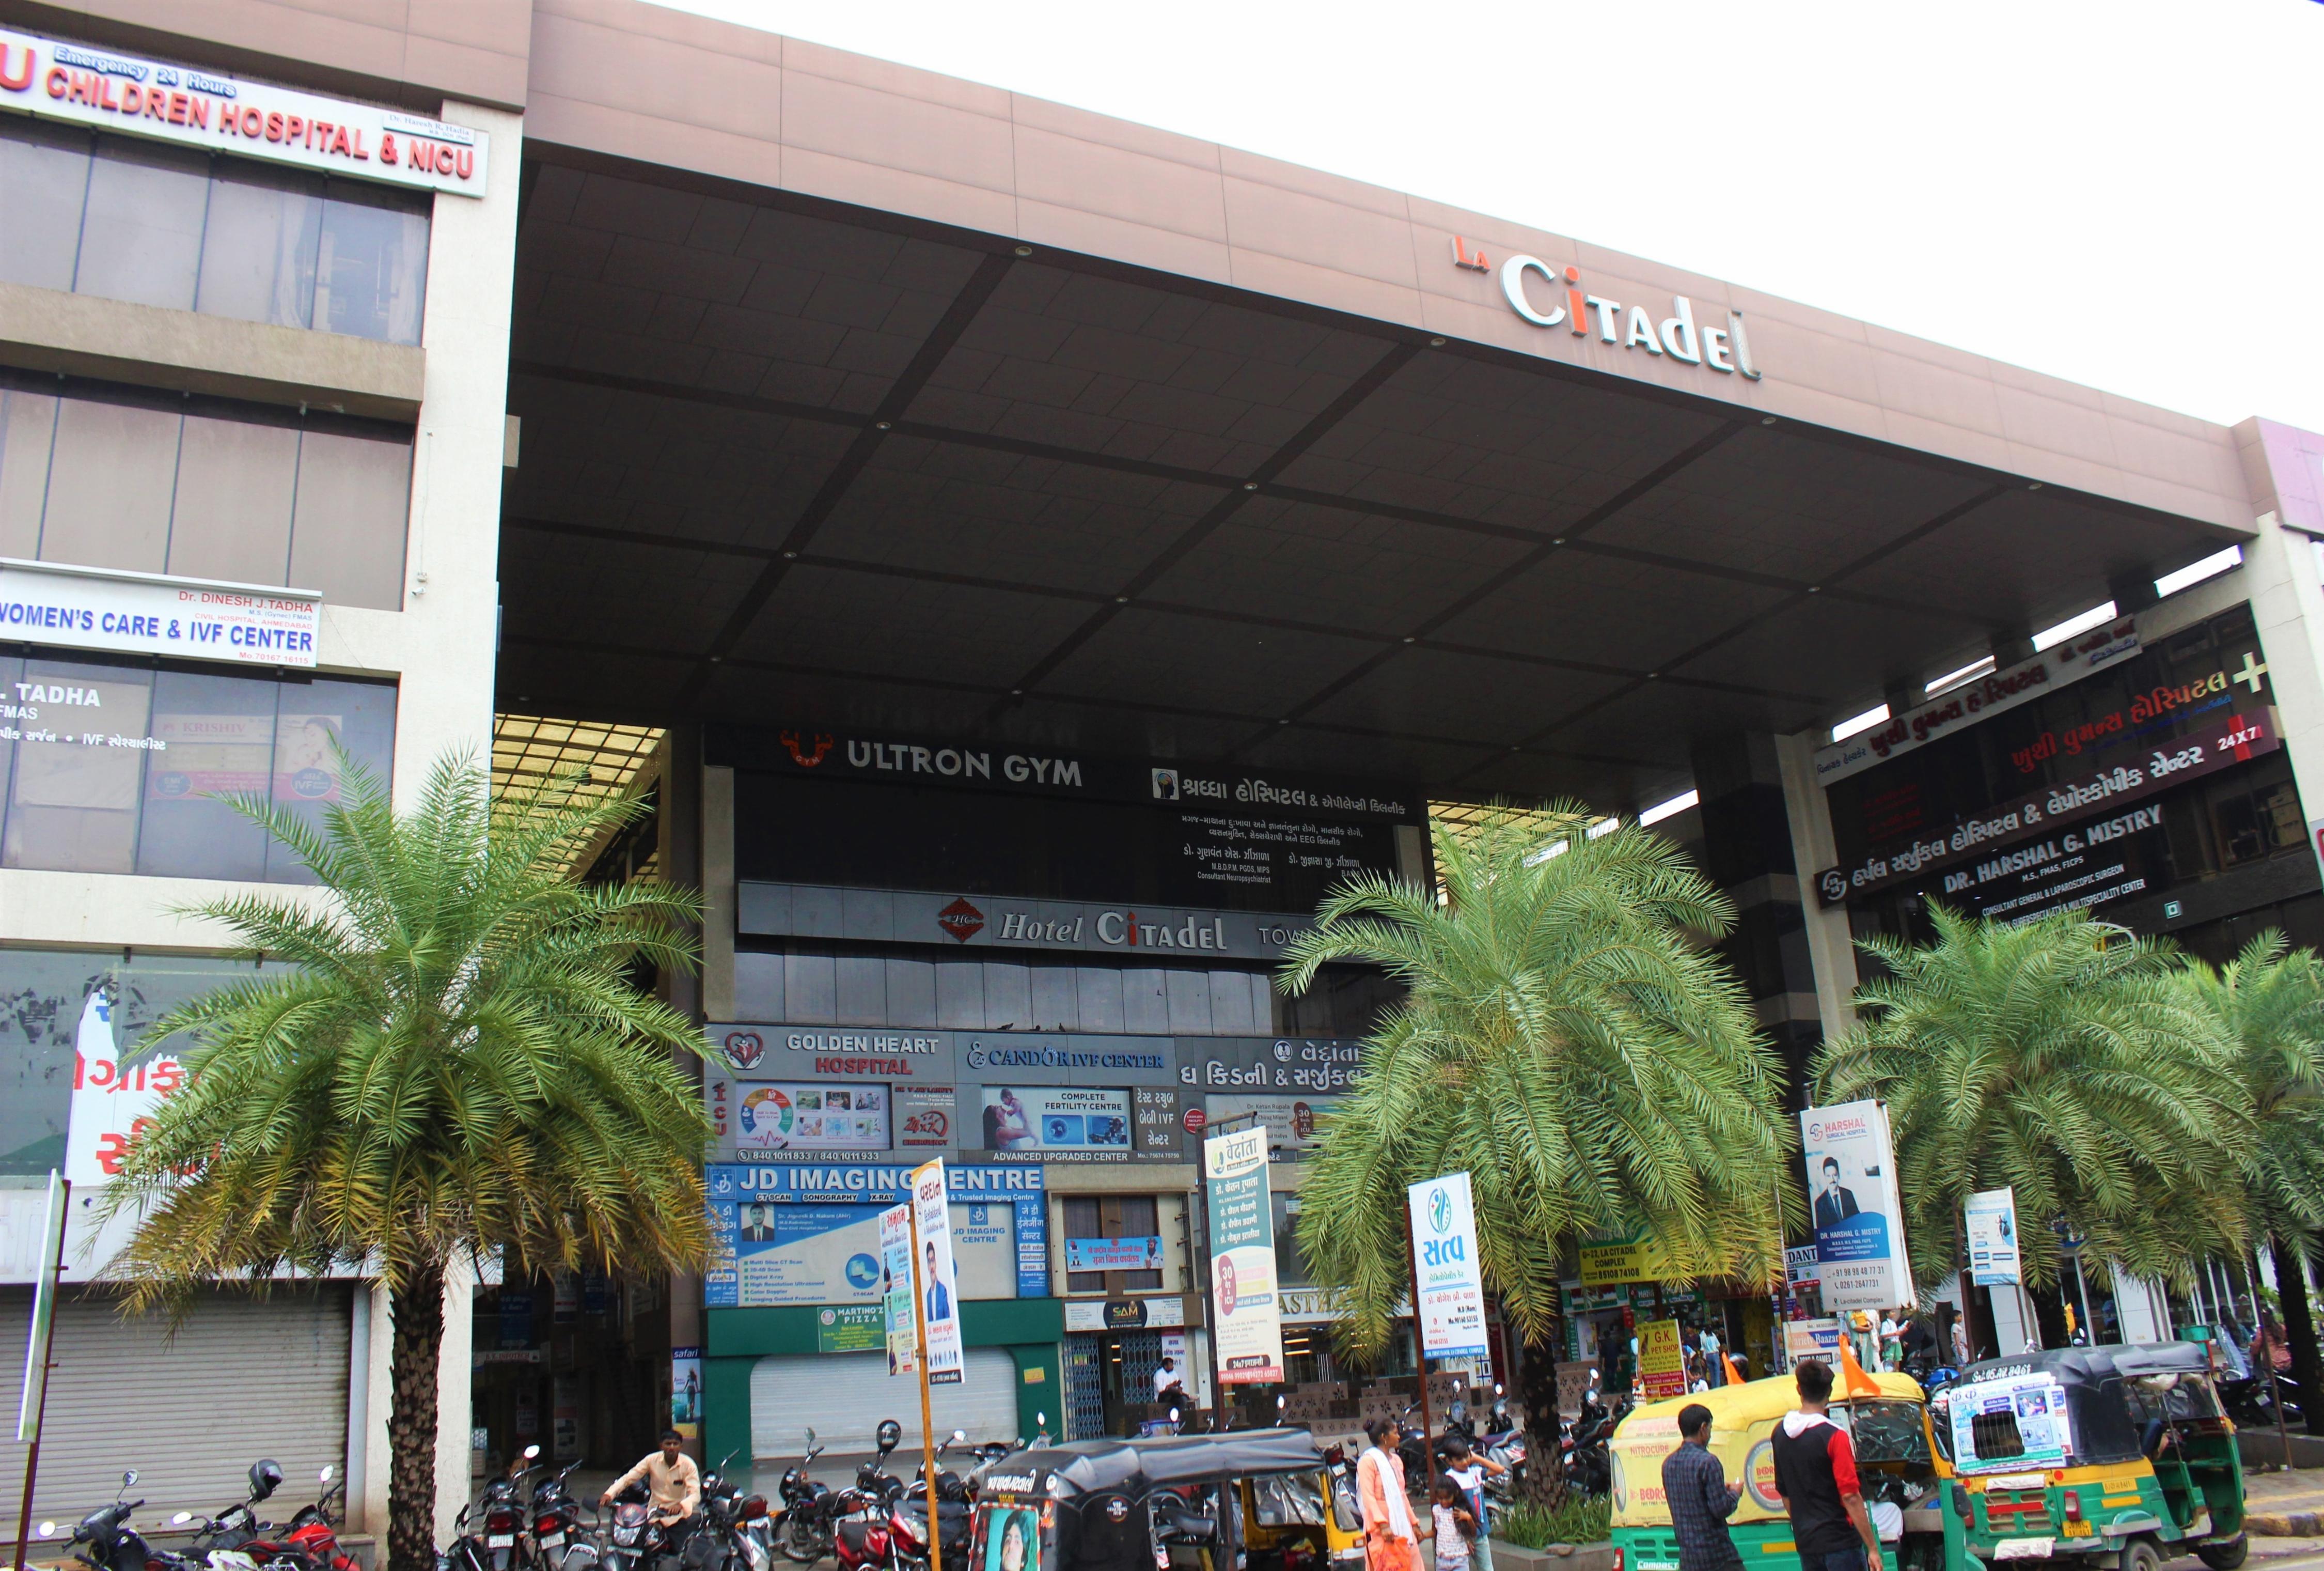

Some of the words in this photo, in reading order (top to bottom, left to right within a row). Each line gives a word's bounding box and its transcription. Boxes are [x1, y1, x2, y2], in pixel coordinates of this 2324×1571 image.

[53, 45, 149, 83] Emergency
[156, 68, 178, 87] 24
[186, 71, 237, 99] Hours
[45, 66, 210, 131] CHILDREN
[217, 101, 369, 160] HOSPITAL
[380, 133, 399, 165] &
[408, 138, 473, 180] NICU
[389, 114, 402, 123] Dr.
[1451, 236, 1491, 274] LA
[179, 590, 196, 603] Dr.
[201, 593, 252, 608] DINESH
[256, 598, 312, 613] J.TADHA
[265, 611, 291, 619] (Gynec)
[261, 619, 312, 629] AHMEDABAD
[102, 613, 159, 637] CARE
[167, 620, 181, 639] &
[191, 622, 223, 643] IVF
[230, 626, 312, 651] CENTER
[284, 655, 309, 665] 16115
[15, 682, 101, 707] TADHA
[2010, 732, 2058, 774] ખુશી
[2063, 712, 2124, 755] વુમન્સ
[2129, 671, 2229, 724] હોસ્પિટલ
[26, 727, 56, 743] સર્જન
[83, 733, 104, 745] IVF
[848, 740, 990, 780] ULTRON
[1003, 754, 1082, 787] GYM
[1235, 778, 1306, 806] હોસ્પિટલ
[1310, 794, 1318, 806] &
[1950, 812, 2020, 851] હોસ્પિટલ
[2023, 803, 2043, 825] &
[2149, 746, 2205, 779] સેન્ટર
[1253, 820, 1266, 830] અને
[1285, 832, 1297, 843] અને
[1300, 835, 1315, 844] EEG
[1197, 845, 1222, 861] ગુણવંત
[1943, 871, 1976, 894] DR.
[1976, 840, 2063, 883] HARSHAL
[2063, 834, 2084, 853] G.
[2086, 803, 2163, 847] MISTRY
[1239, 865, 1256, 874] PGDS,
[1257, 866, 1270, 874] MIPS
[2040, 864, 2062, 877] FMAS,
[2062, 856, 2084, 869] FICPS
[1197, 871, 1226, 881] Consultant
[1227, 873, 1271, 884] Neuropsychiatrist
[1982, 899, 2018, 917] CONSULTANT
[2018, 891, 2045, 908] GENERAL
[2045, 890, 2050, 898] &
[2050, 875, 2095, 897] LAPAROSCOPIC
[2094, 863, 2125, 883] SURGEON
[2068, 885, 2121, 912] MULTISPECIALITY
[2120, 878, 2146, 898] CENTER
[1000, 913, 1083, 943] Hotel
[787, 1034, 868, 1052] GOLDEN
[873, 1037, 939, 1054] HEART
[1301, 1040, 1360, 1062] વેદાંતા
[989, 1046, 1069, 1067] CANDOR
[1072, 1053, 1099, 1067] IVF
[1102, 1054, 1165, 1068] CENTER
[815, 1057, 913, 1075] HOSPITAL
[1206, 1060, 1267, 1085] કિડની
[1275, 1068, 1289, 1086] &
[1137, 1088, 1152, 1103] ટેસ્ટ
[1045, 1102, 1086, 1111] FERTILITY
[1139, 1109, 1156, 1125] બેબી
[1159, 1113, 1174, 1125] IVF
[1825, 1117, 1866, 1132] HARSHAL
[1148, 1133, 1169, 1146] સેન્ટર
[993, 1152, 1041, 1162] ADVANCED
[1044, 1153, 1091, 1162] UPGRADED
[1094, 1153, 1128, 1161] CENTER
[740, 1169, 779, 1190] JD
[789, 1169, 913, 1191] IMAGING
[756, 1193, 792, 1202] CT-SCAN
[803, 1193, 858, 1202] SONOGRAPHY
[869, 1193, 896, 1202] X-RAY
[1830, 1230, 1854, 1238] HARSHAL
[1601, 1248, 1609, 1257] LA
[1609, 1245, 1637, 1256] CITADEL
[1594, 1257, 1626, 1269] COMPLEX
[1222, 1266, 1233, 1280] 30
[1620, 1267, 1640, 1278] 74108
[1843, 1268, 1851, 1277] 98
[1852, 1267, 1859, 1276] 98
[1860, 1267, 1868, 1275] 48
[1877, 1266, 1885, 1274] 31
[1224, 1296, 1233, 1305] ICU
[838, 1306, 884, 1316] MARTINO'Z
[1112, 1306, 1138, 1317] SAM
[844, 1315, 878, 1324] PIZZA
[1654, 1329, 1673, 1343] G.K.
[1815, 1333, 1839, 1344] Baazar
[674, 1348, 698, 1359] safari
[1663, 1344, 1678, 1353] SHOP
[1630, 1444, 1669, 1456] NITROCURE
